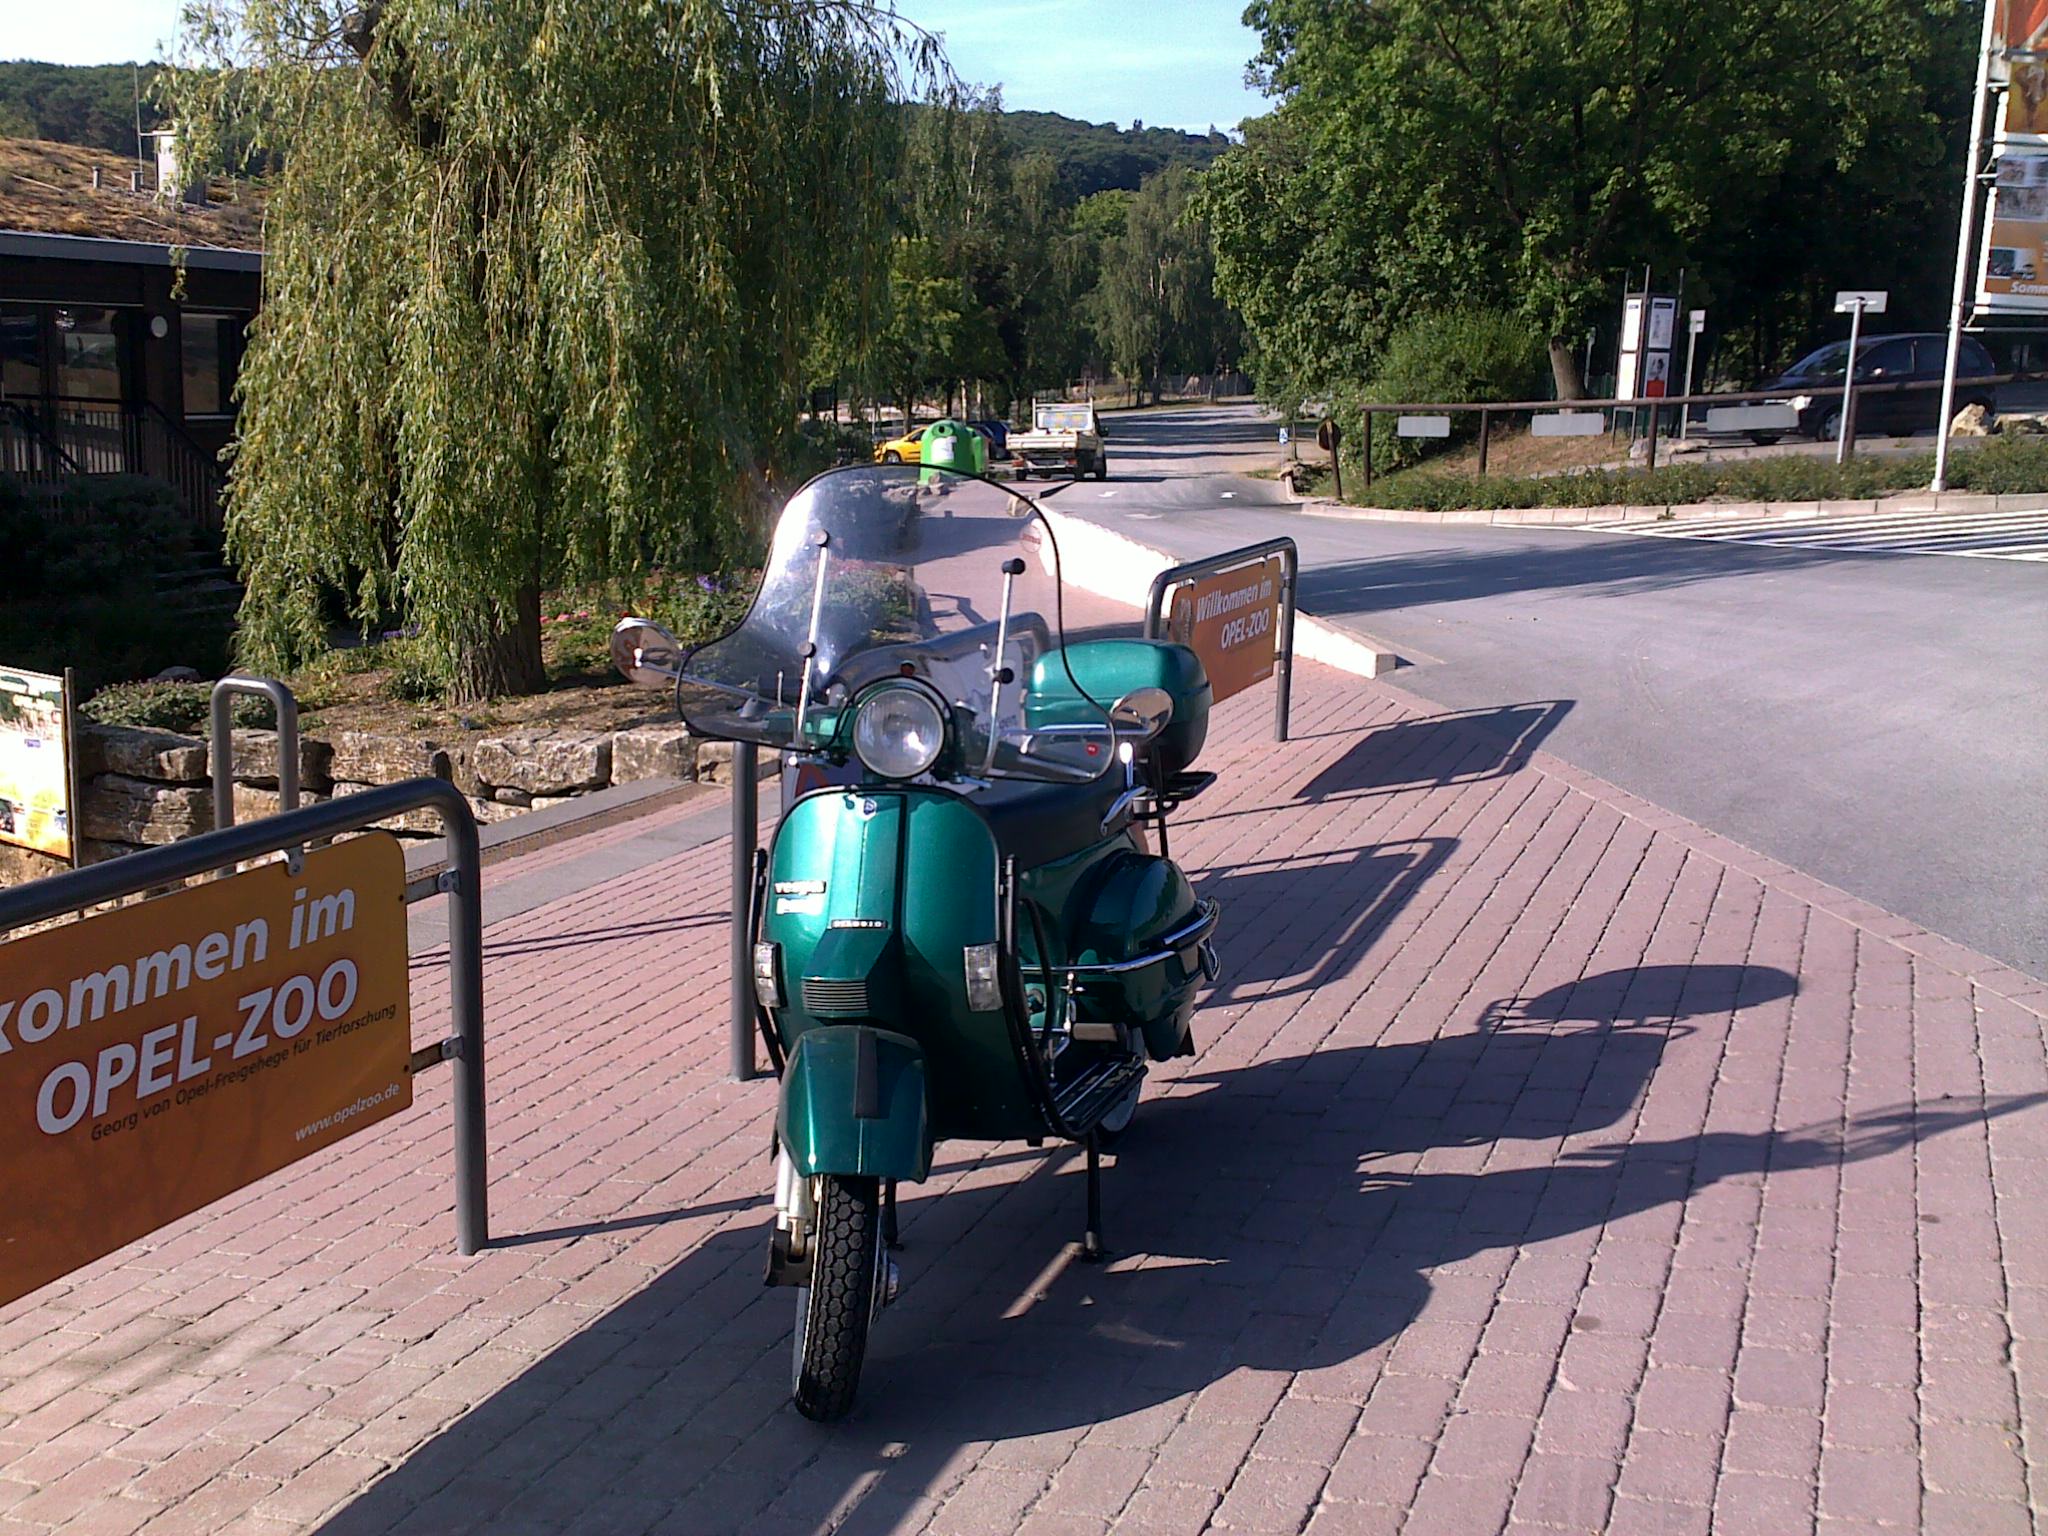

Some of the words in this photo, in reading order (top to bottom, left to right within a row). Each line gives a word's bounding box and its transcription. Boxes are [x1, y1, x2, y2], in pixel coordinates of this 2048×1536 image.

[1196, 583, 1258, 622] Willkommen
[1260, 576, 1272, 600] im
[1221, 608, 1269, 649] OPEL-ZOO
[289, 887, 356, 949] im
[36, 959, 359, 1134] OPEL-ZOO
[91, 1111, 138, 1140] Georg
[143, 1099, 171, 1119] von
[175, 1048, 289, 1105] Opel-Freigehege
[293, 1038, 312, 1057] für
[316, 1003, 397, 1046] Tierforschung
[295, 1083, 400, 1141] www.opelzoo.de
